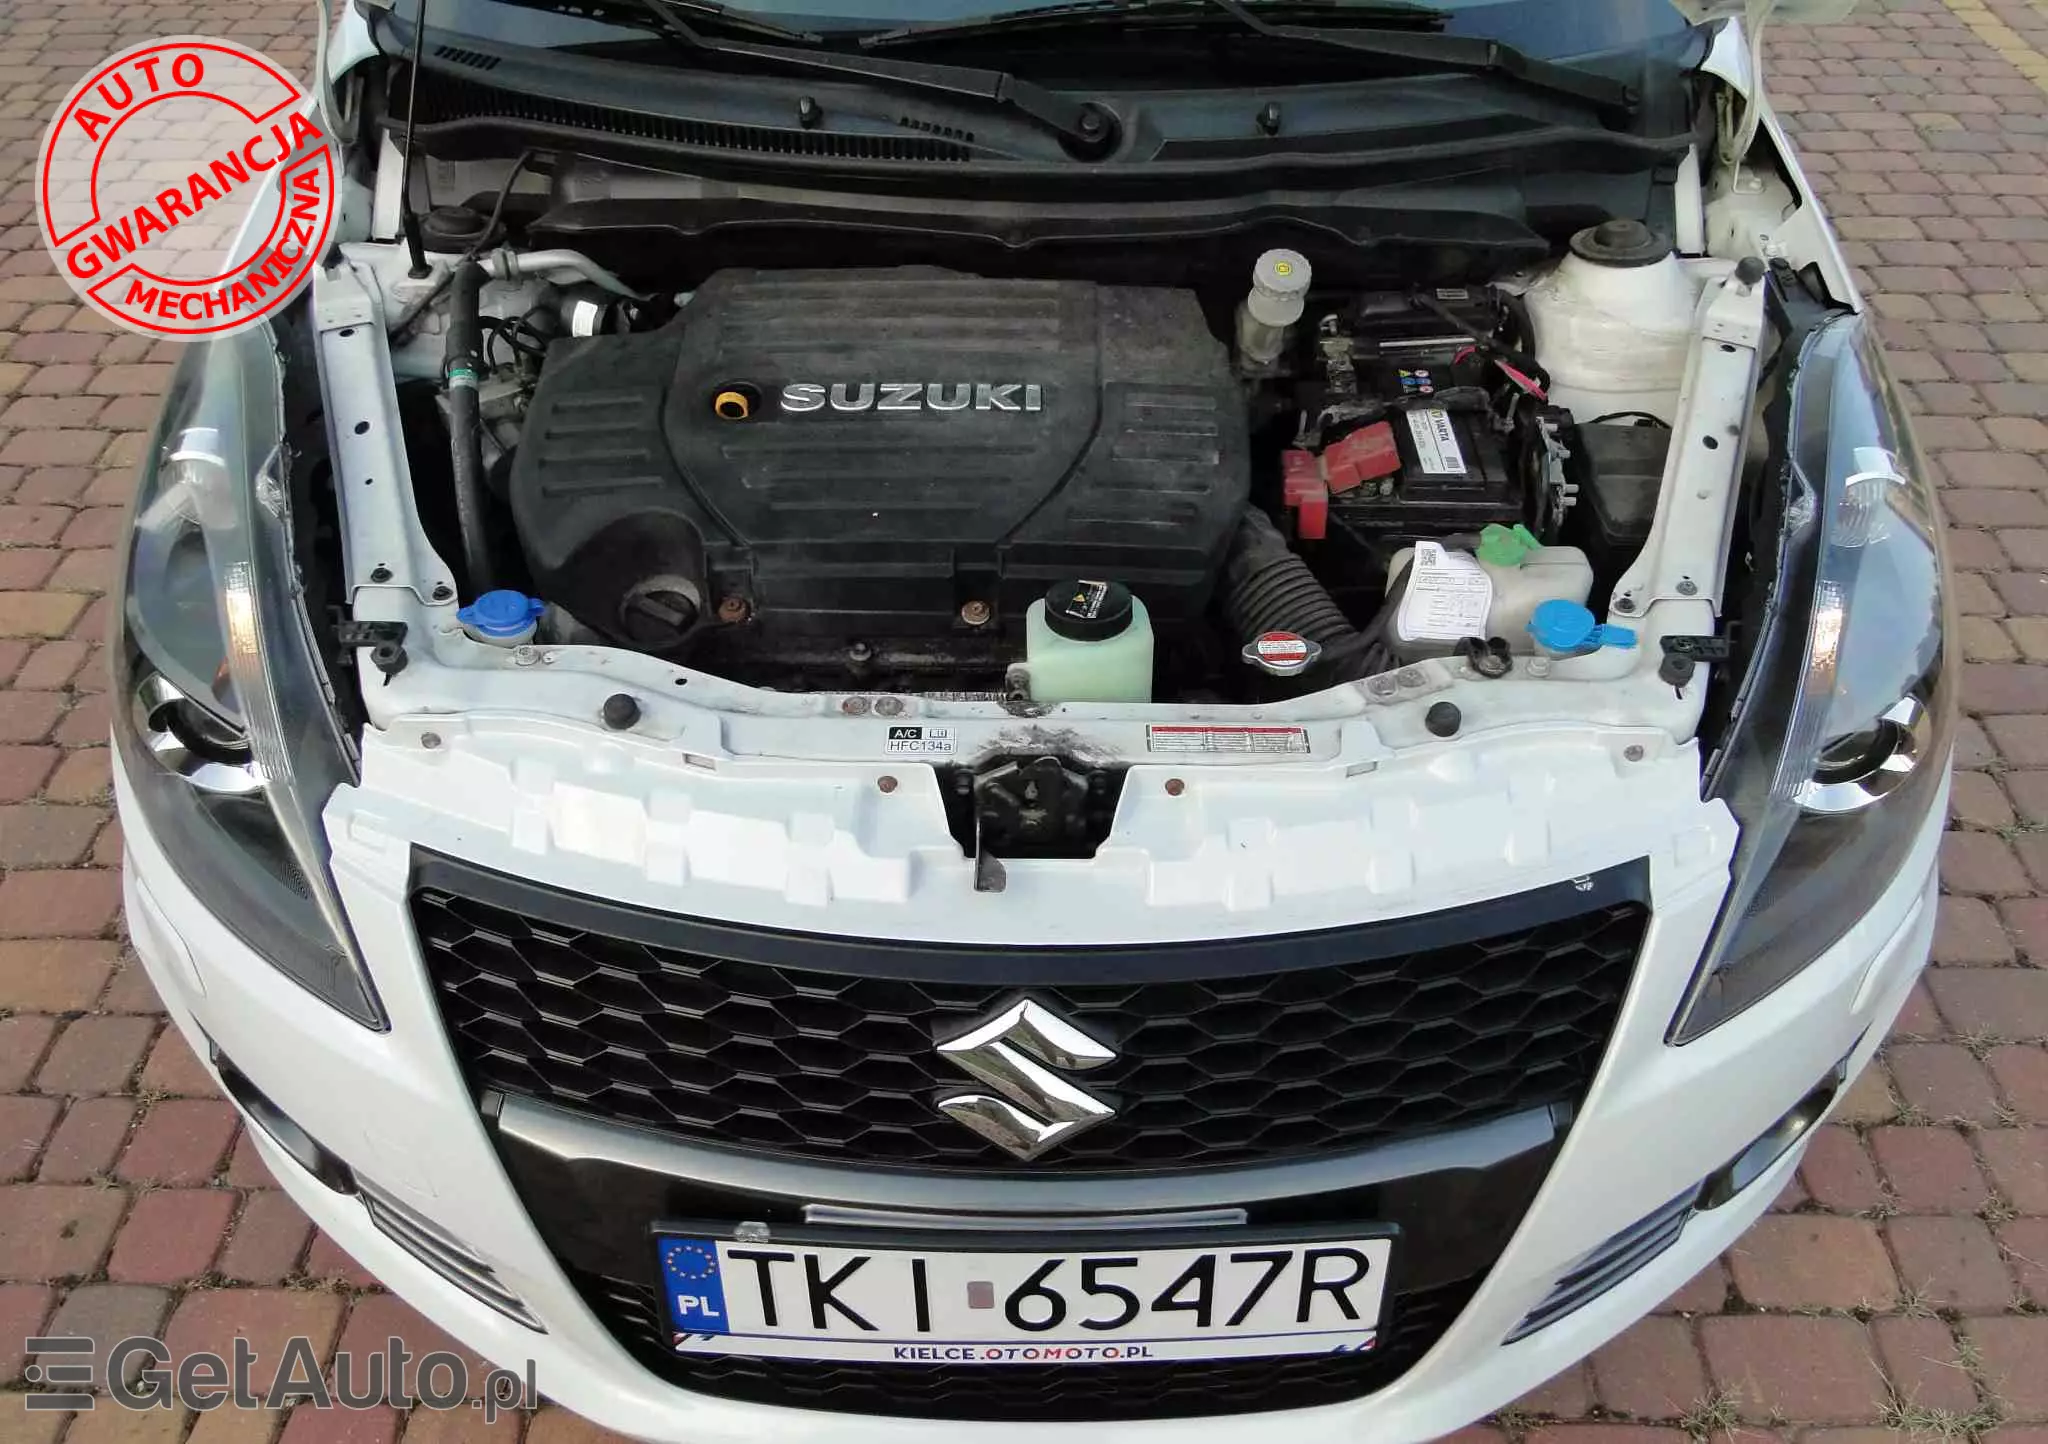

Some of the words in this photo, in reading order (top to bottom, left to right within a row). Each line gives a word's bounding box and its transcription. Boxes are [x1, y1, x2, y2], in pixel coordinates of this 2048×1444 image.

[780, 383, 1042, 412] SUZUKI
[889, 740, 952, 751] HFC134a
[894, 729, 918, 739] A/C
[1004, 1246, 1371, 1332] 6547R
[677, 1294, 720, 1317] PL
